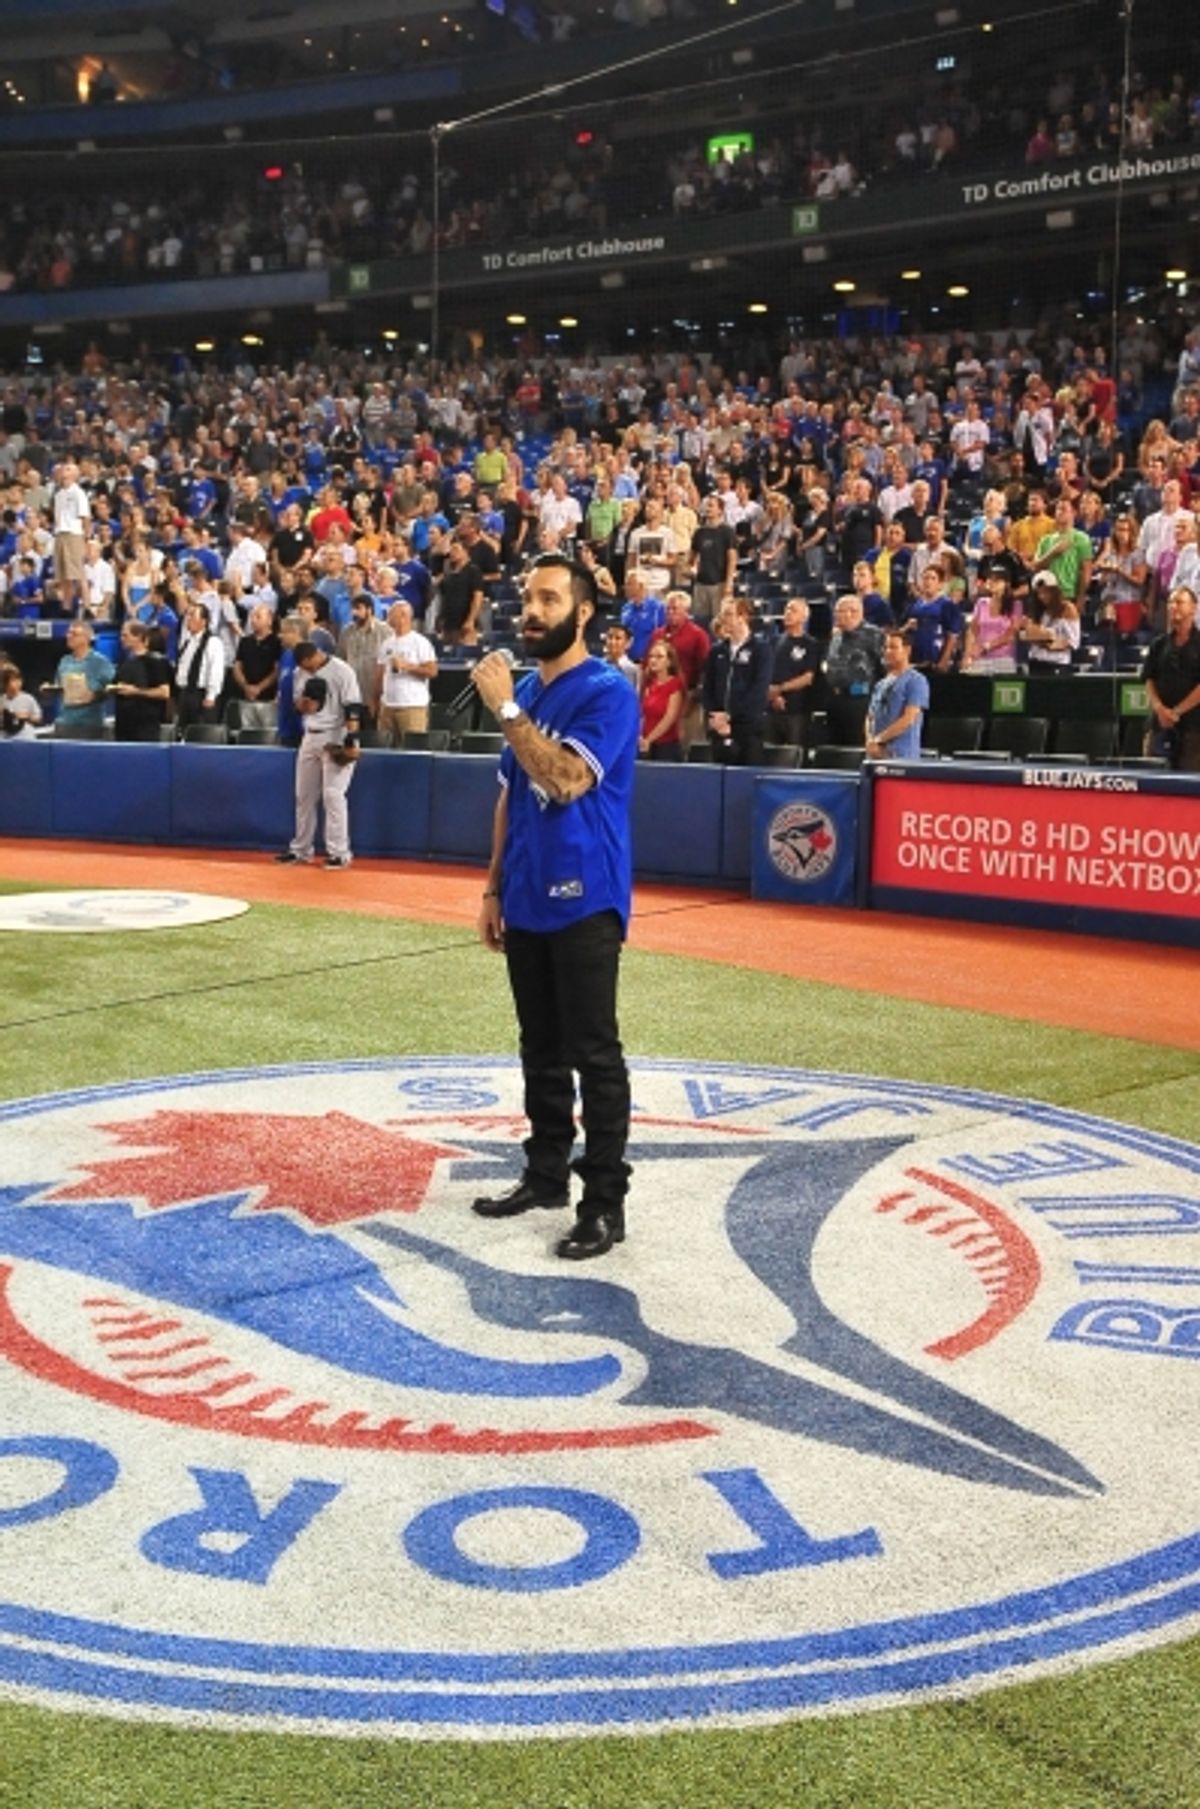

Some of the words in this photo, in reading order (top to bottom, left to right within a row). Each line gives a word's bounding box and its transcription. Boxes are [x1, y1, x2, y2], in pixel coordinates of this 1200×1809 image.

[962, 186, 988, 203] TD
[994, 168, 1081, 199] Comfort
[795, 210, 817, 228] TD
[482, 255, 501, 270] TD
[506, 246, 573, 267] Comfort
[576, 236, 665, 259] Clubhouse
[996, 687, 1022, 707] TD
[901, 812, 1012, 846] RECORD
[1020, 821, 1037, 848] 8
[1047, 823, 1090, 852] HD
[1100, 826, 1200, 861] SHOW
[898, 842, 971, 873] ONCE
[980, 850, 1055, 882] WITH
